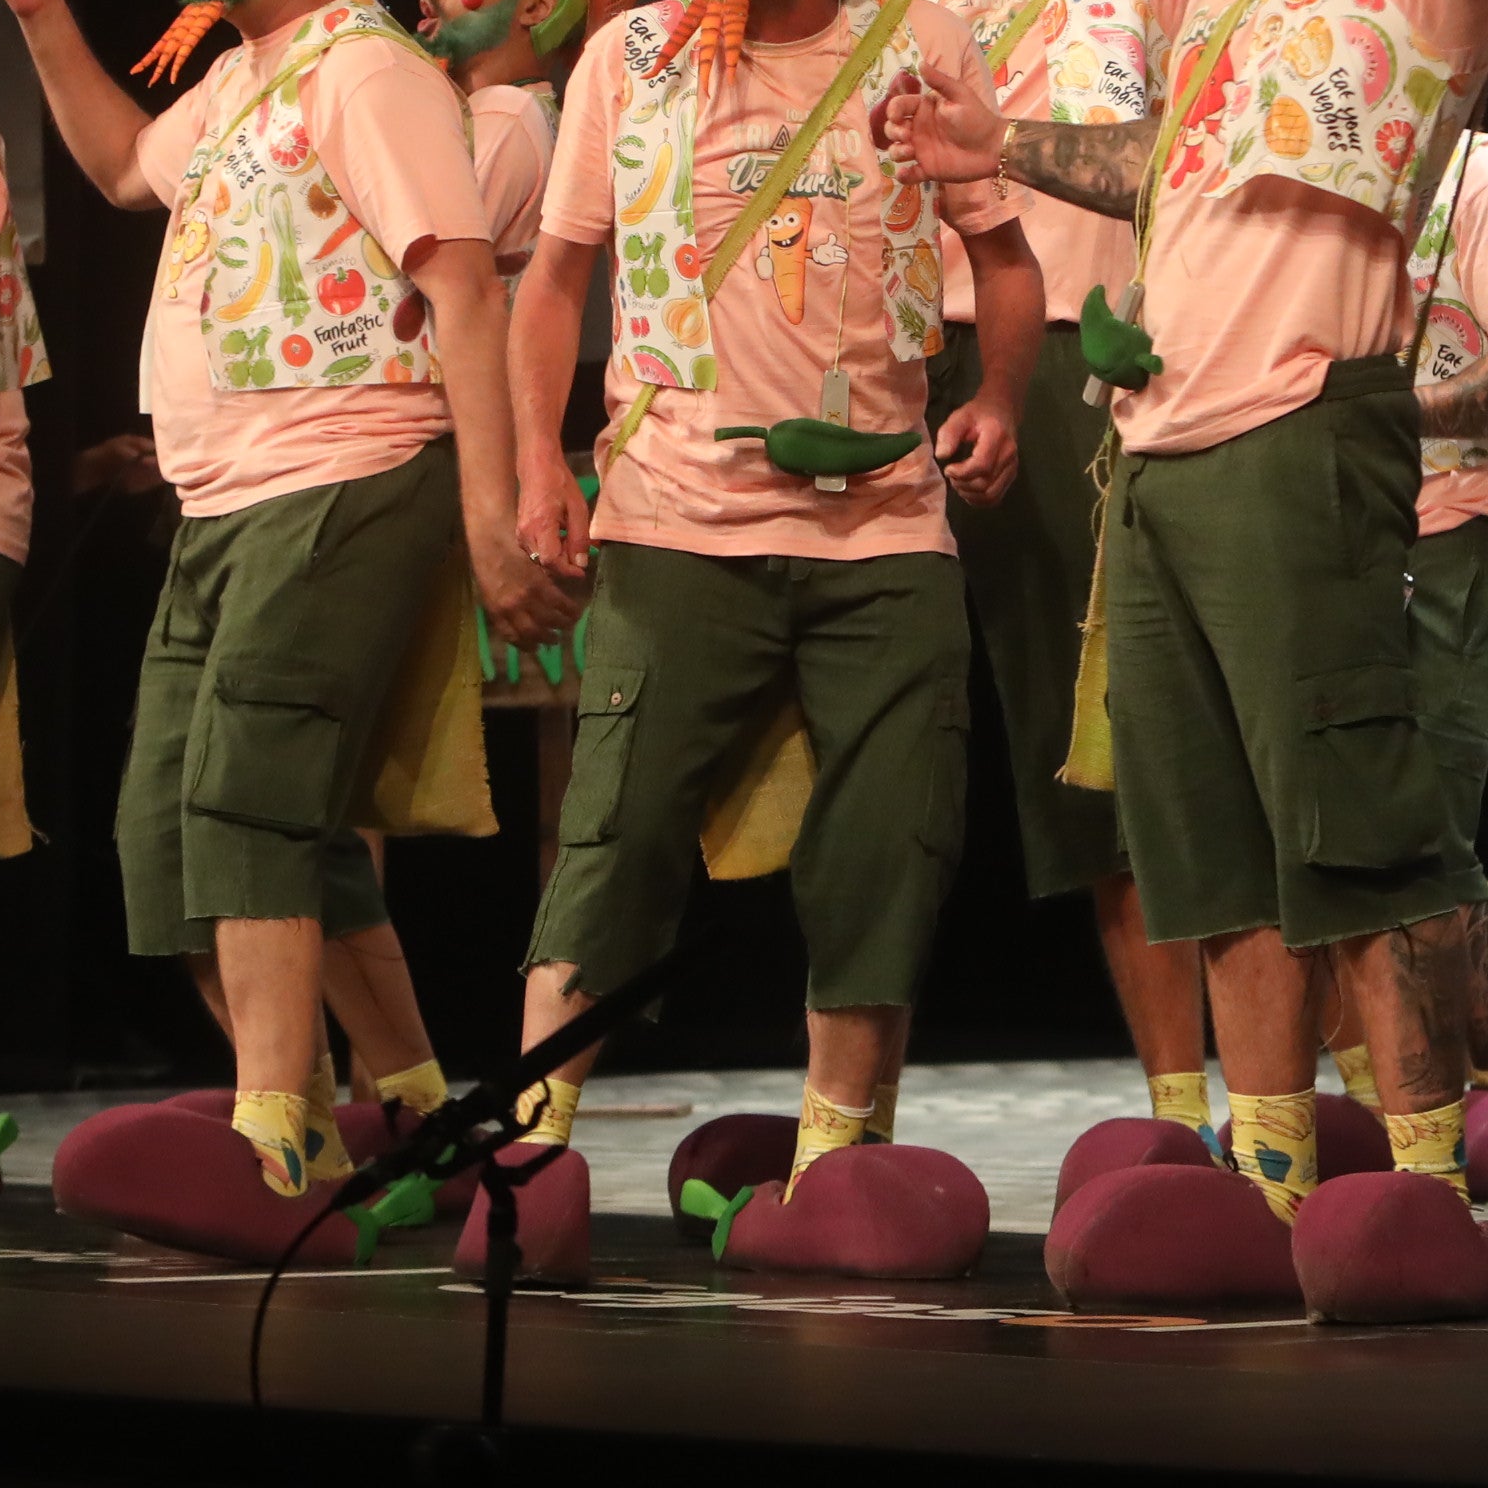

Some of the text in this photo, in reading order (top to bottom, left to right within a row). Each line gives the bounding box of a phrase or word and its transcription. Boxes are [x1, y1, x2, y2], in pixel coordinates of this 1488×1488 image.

[625, 34, 667, 89] eggis
[629, 16, 682, 79] Eat yur
[1098, 78, 1144, 116] Veggies
[1104, 61, 1145, 104] Eat yo
[1310, 81, 1348, 152] Veggies
[1329, 67, 1363, 155] Eat your
[223, 153, 255, 190] ggies
[726, 153, 852, 202] Veuras
[314, 314, 384, 345] Fantastic
[331, 333, 368, 356] Fruit
[1437, 344, 1463, 368] Eat
